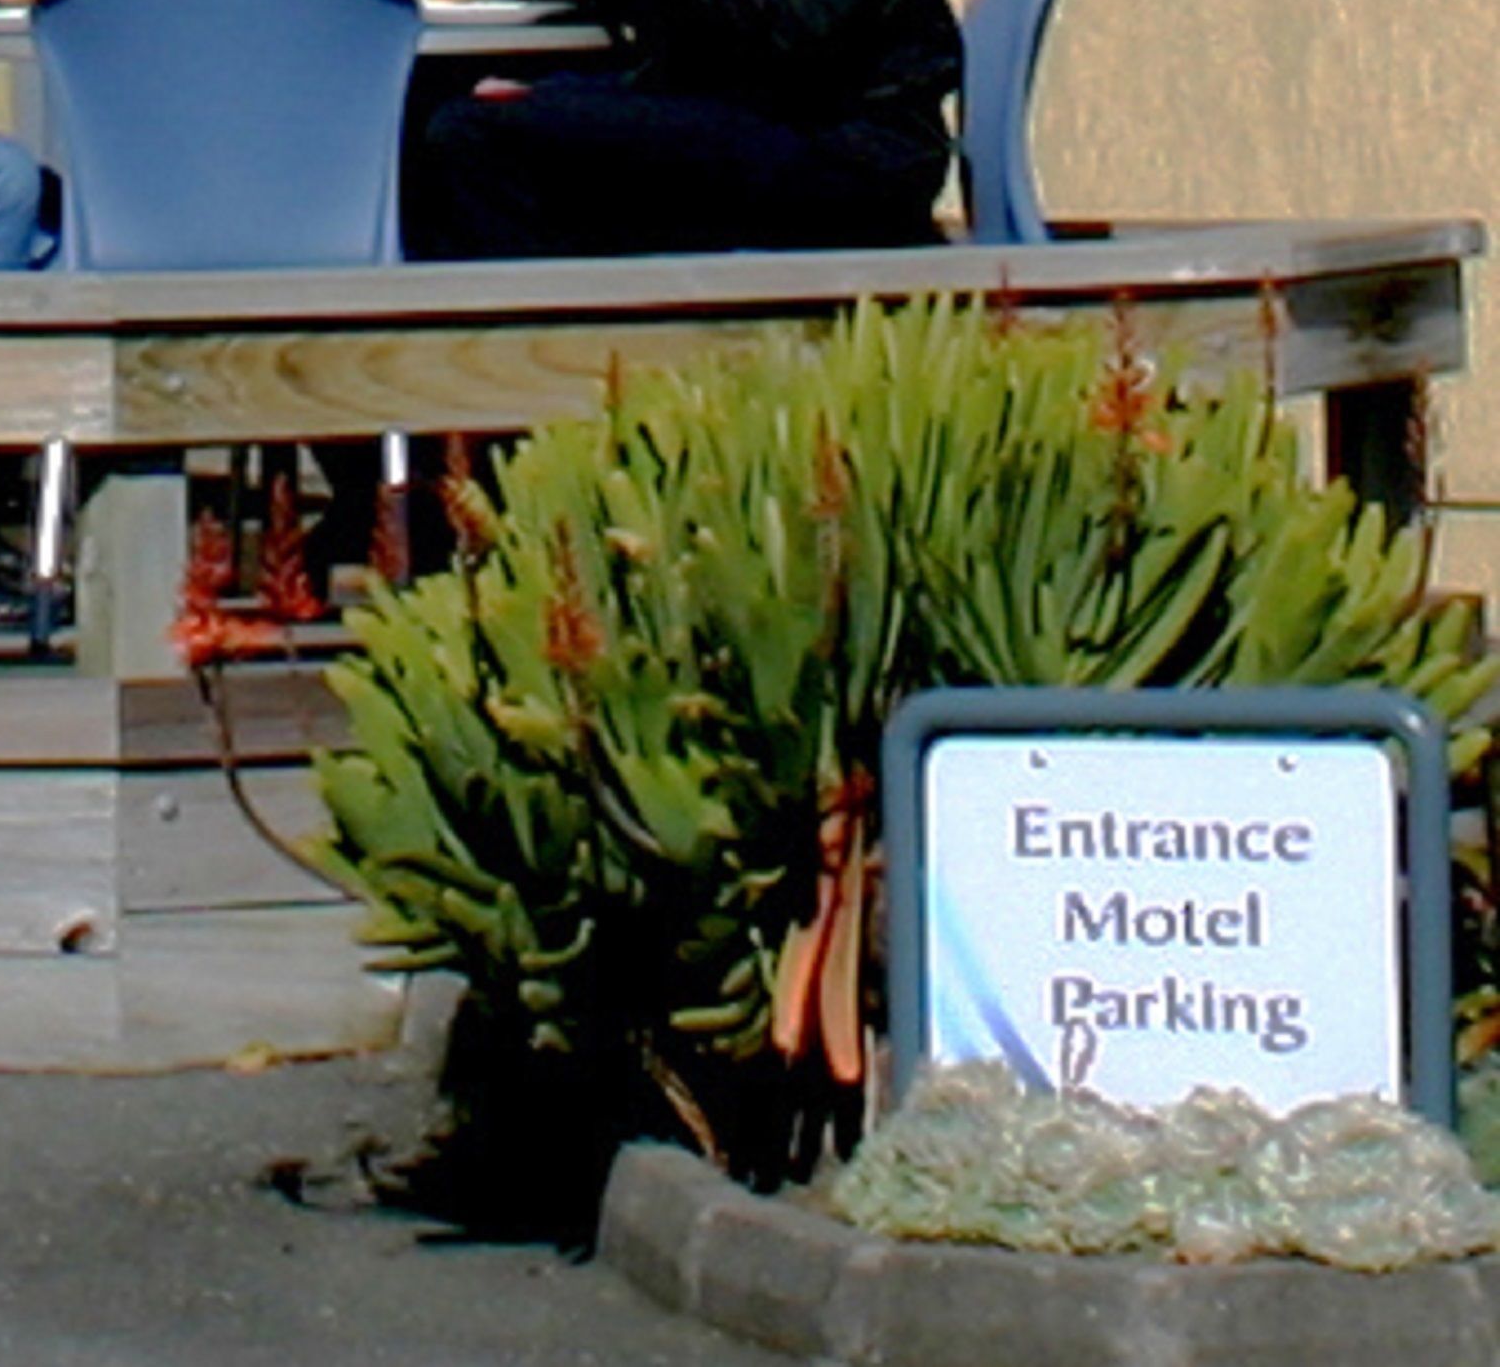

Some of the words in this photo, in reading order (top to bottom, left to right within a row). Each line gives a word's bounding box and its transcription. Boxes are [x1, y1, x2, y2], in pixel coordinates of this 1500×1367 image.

[1013, 806, 1312, 862] Entrance
[1063, 891, 1261, 946] Motel
[1051, 976, 1308, 1053] Parking
